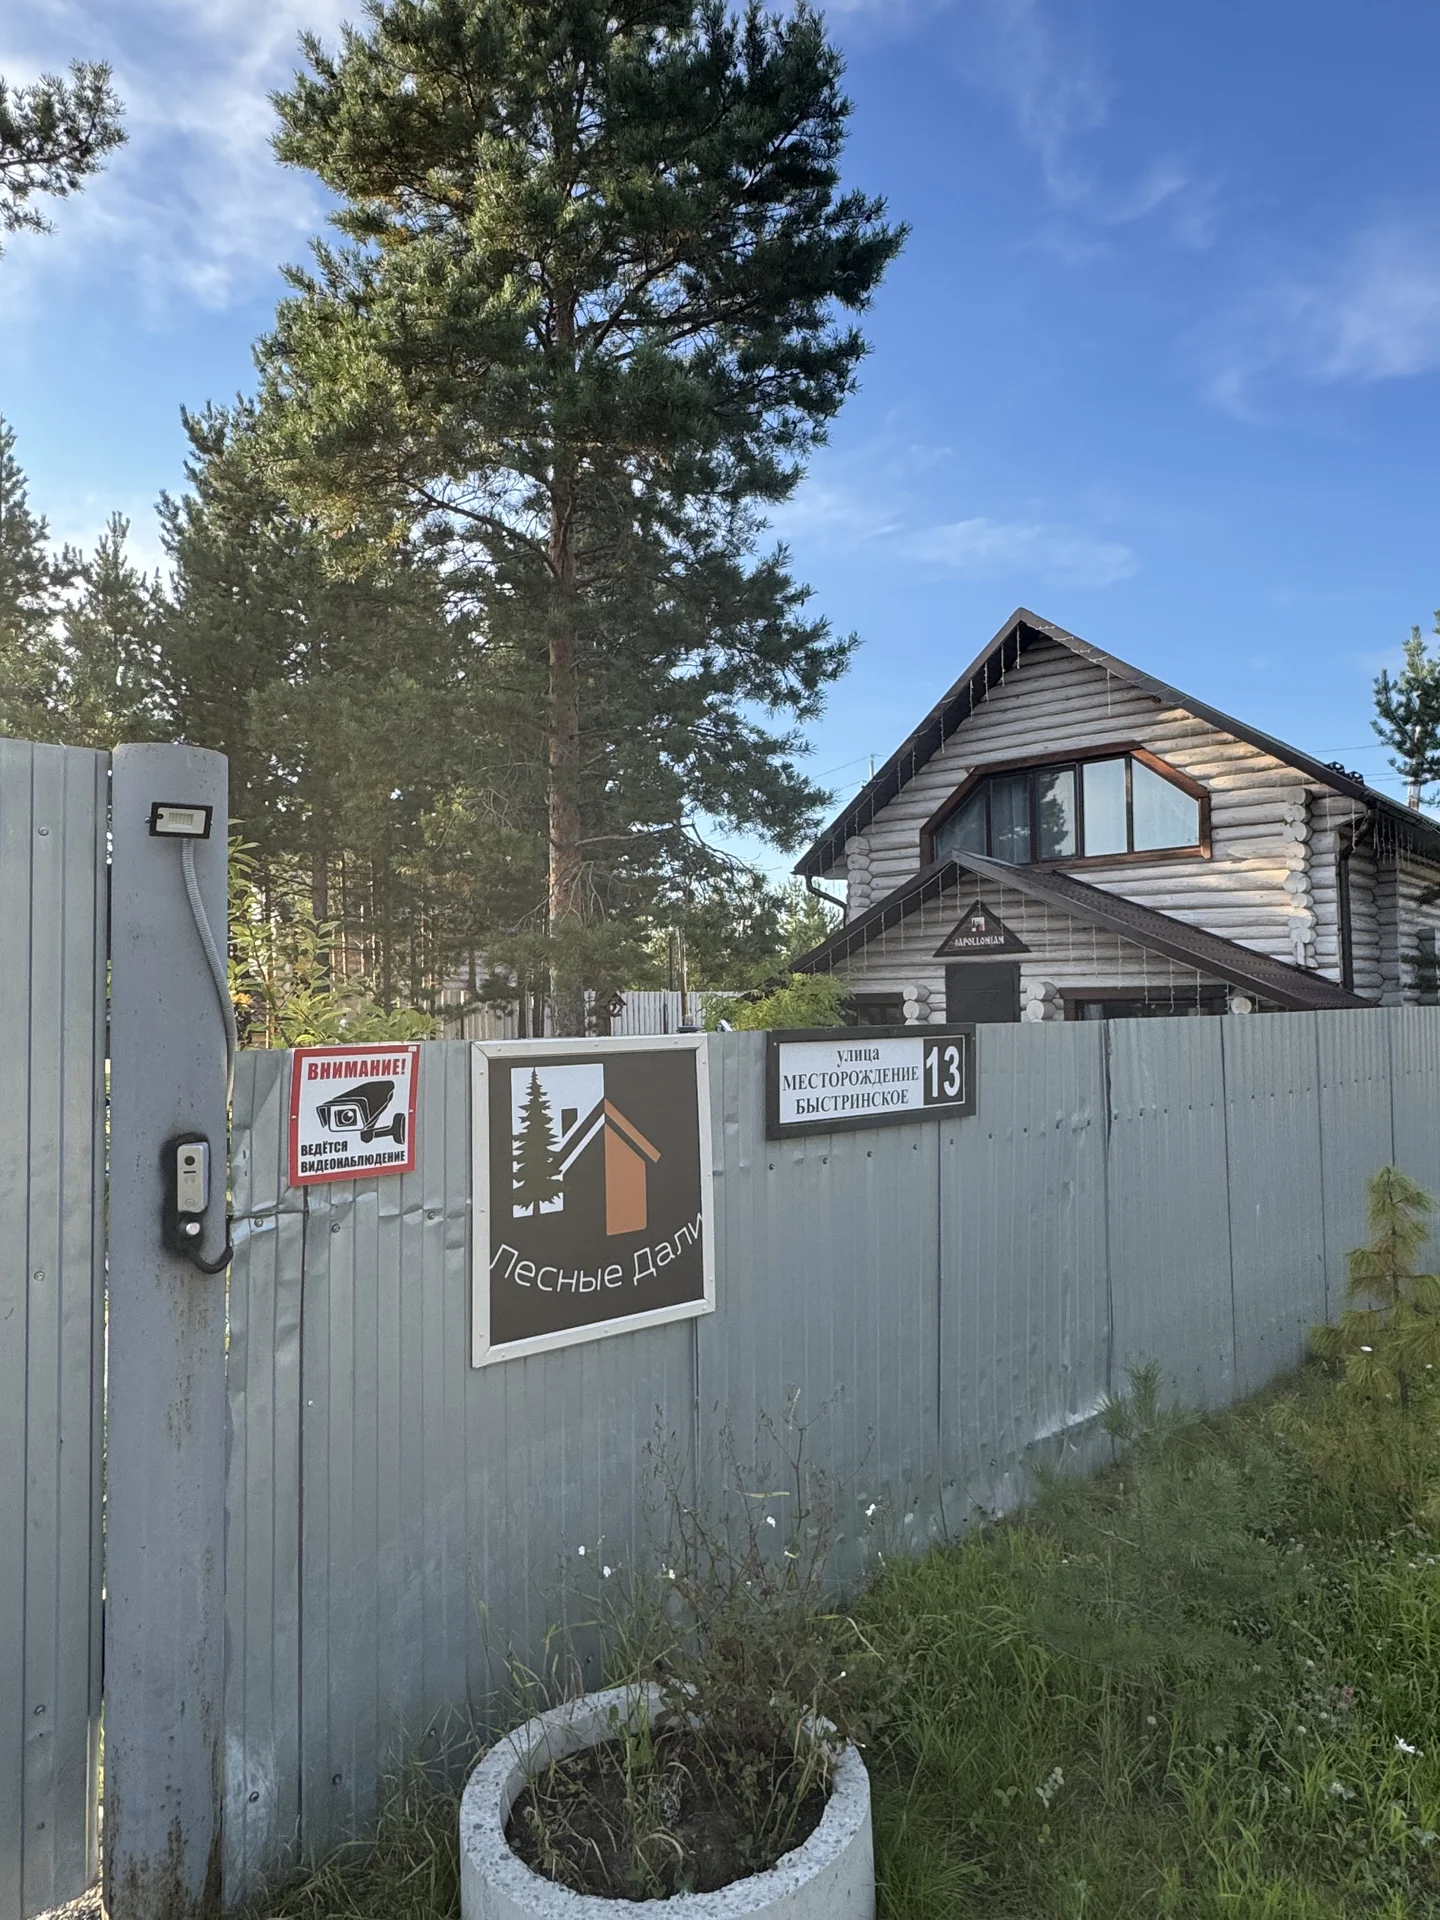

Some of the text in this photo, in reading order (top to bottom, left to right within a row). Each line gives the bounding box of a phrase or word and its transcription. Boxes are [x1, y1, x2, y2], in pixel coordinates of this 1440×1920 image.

[307, 1058, 406, 1080] ВНИМАНИЕ!
[836, 1047, 880, 1068] улица
[782, 1066, 919, 1092] МЕСТОРОЖДЕНИЕ
[925, 1045, 961, 1099] 13
[795, 1088, 909, 1115] БЫСТРИНСКОЕ
[300, 1140, 348, 1157] ВЕДЁТСЯ
[300, 1150, 405, 1173] ВИДЕОНАБЛЮДЕНИЕ
[489, 1243, 624, 1293] Лесные
